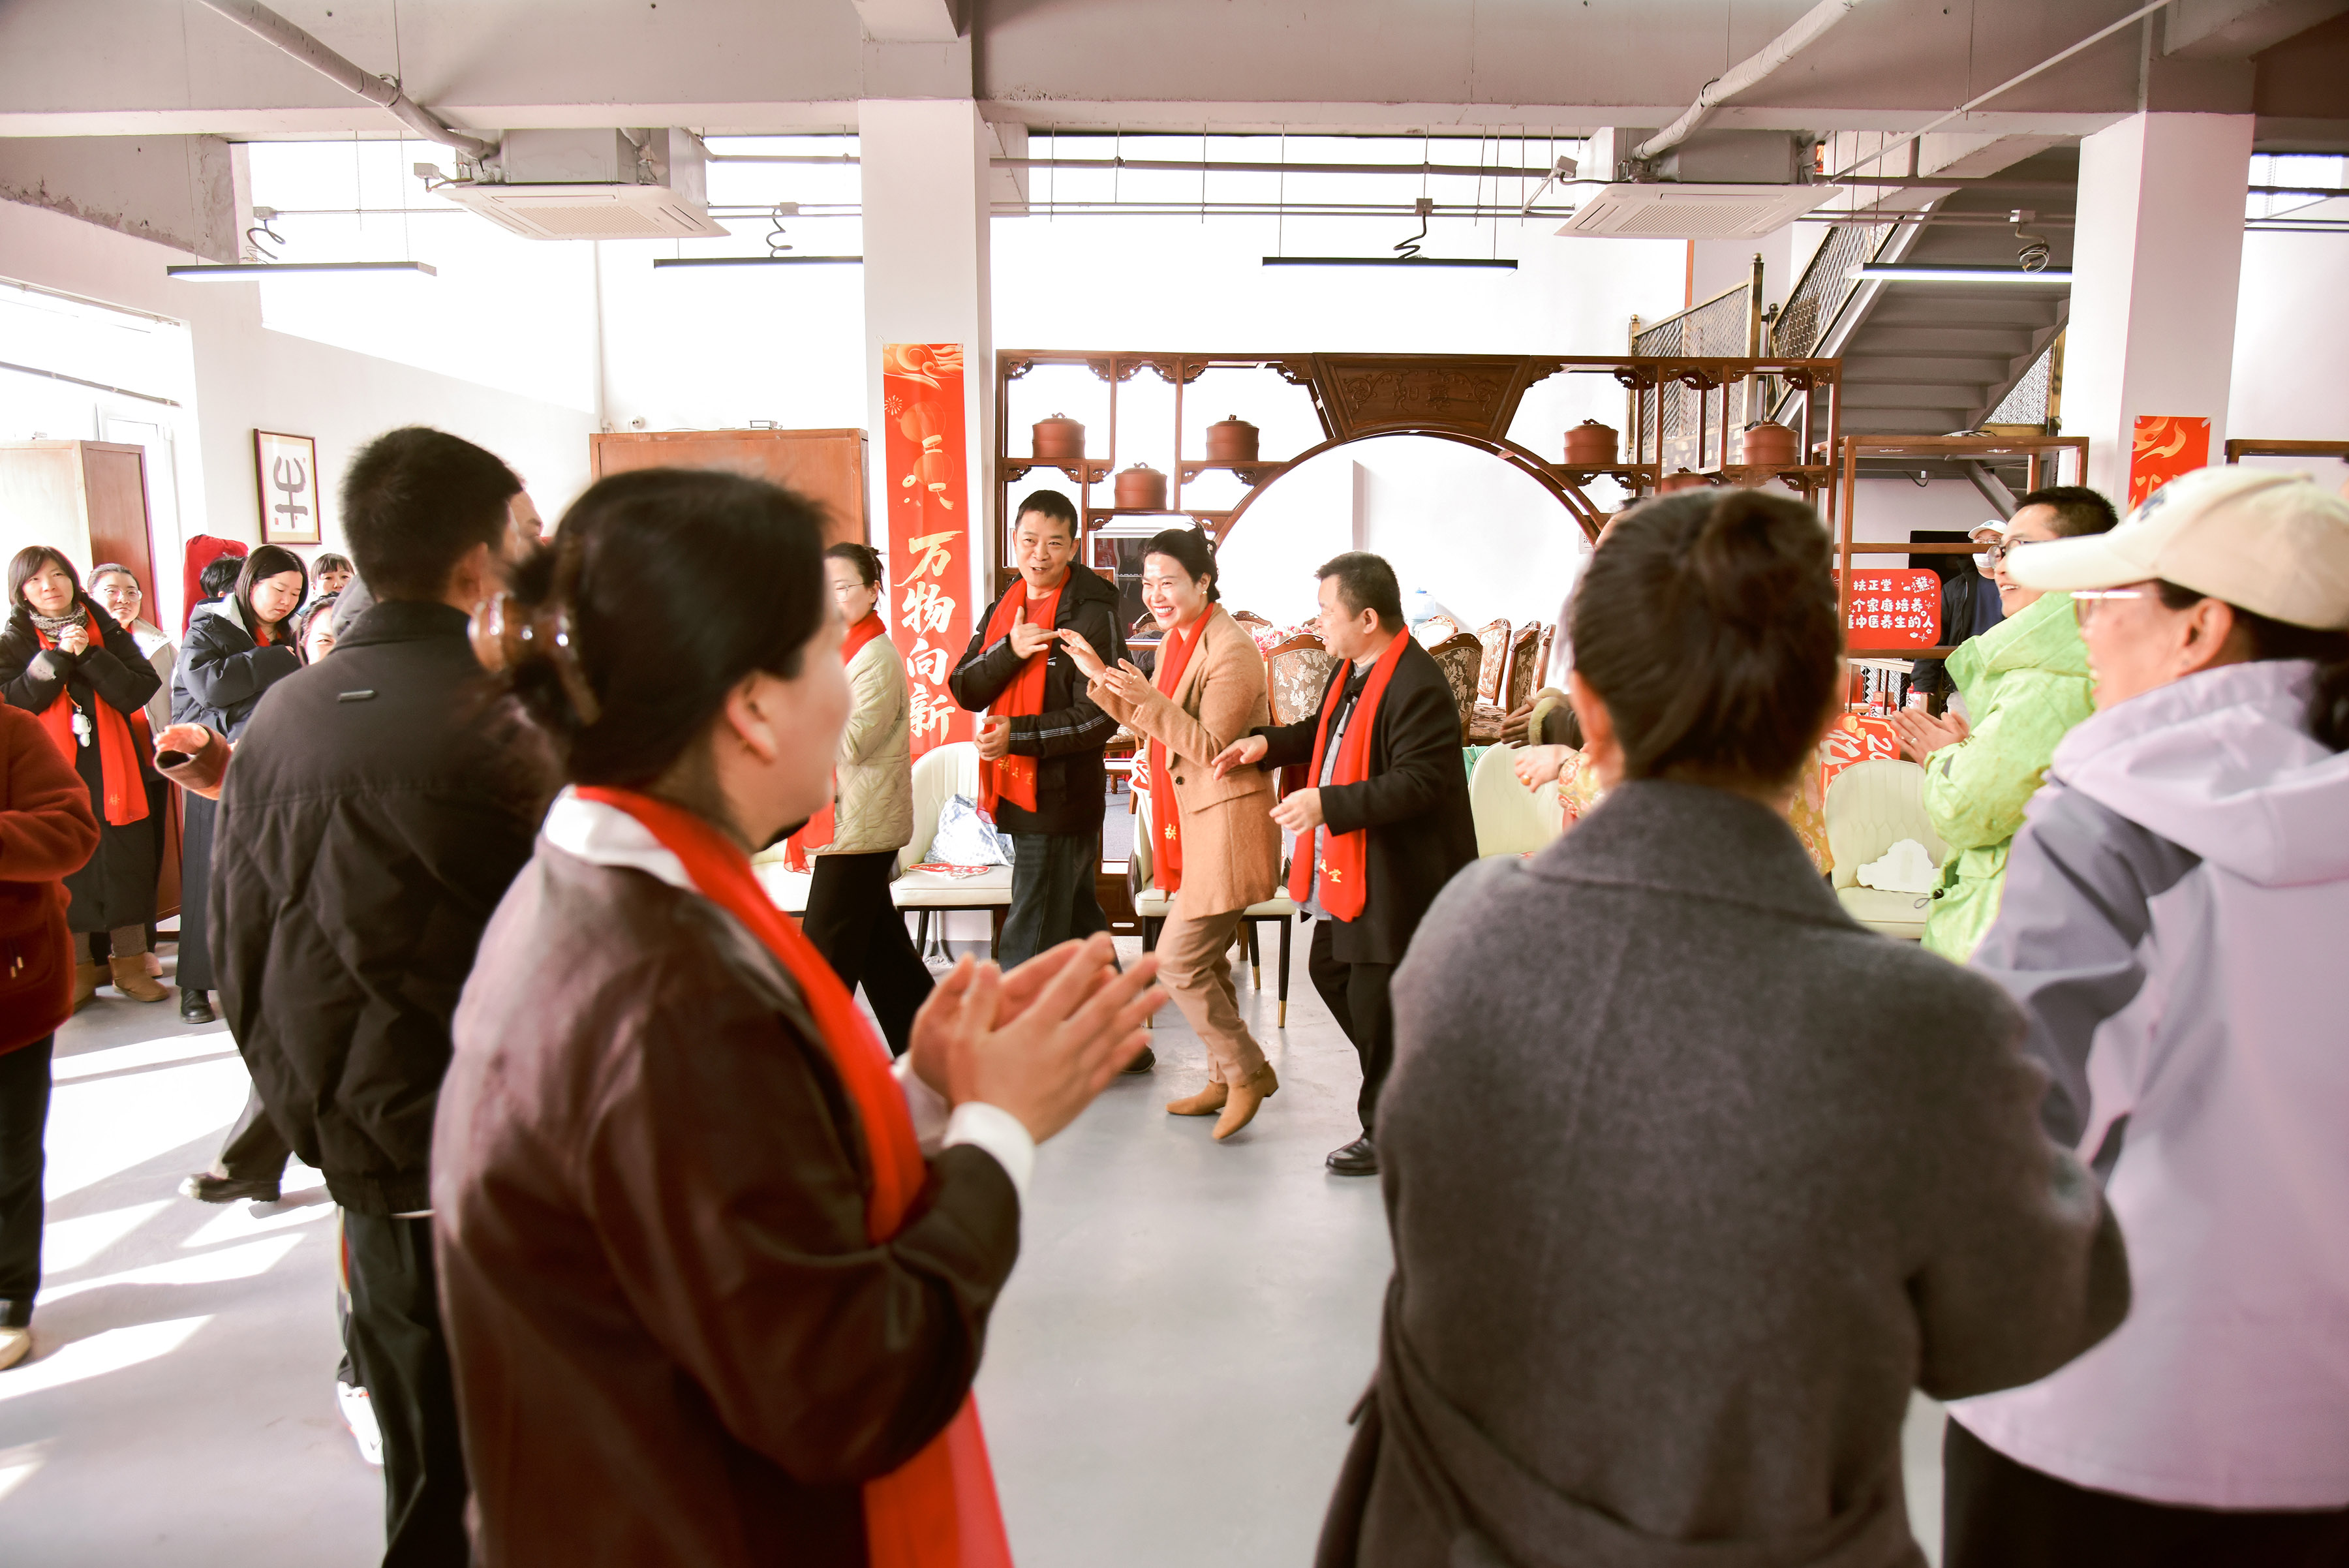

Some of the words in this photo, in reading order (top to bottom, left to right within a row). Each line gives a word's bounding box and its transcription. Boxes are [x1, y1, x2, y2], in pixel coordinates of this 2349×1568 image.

[1853, 579, 1892, 592] 扶正堂
[1852, 597, 1923, 612] 个家庭培养
[895, 530, 964, 745] 万物向新
